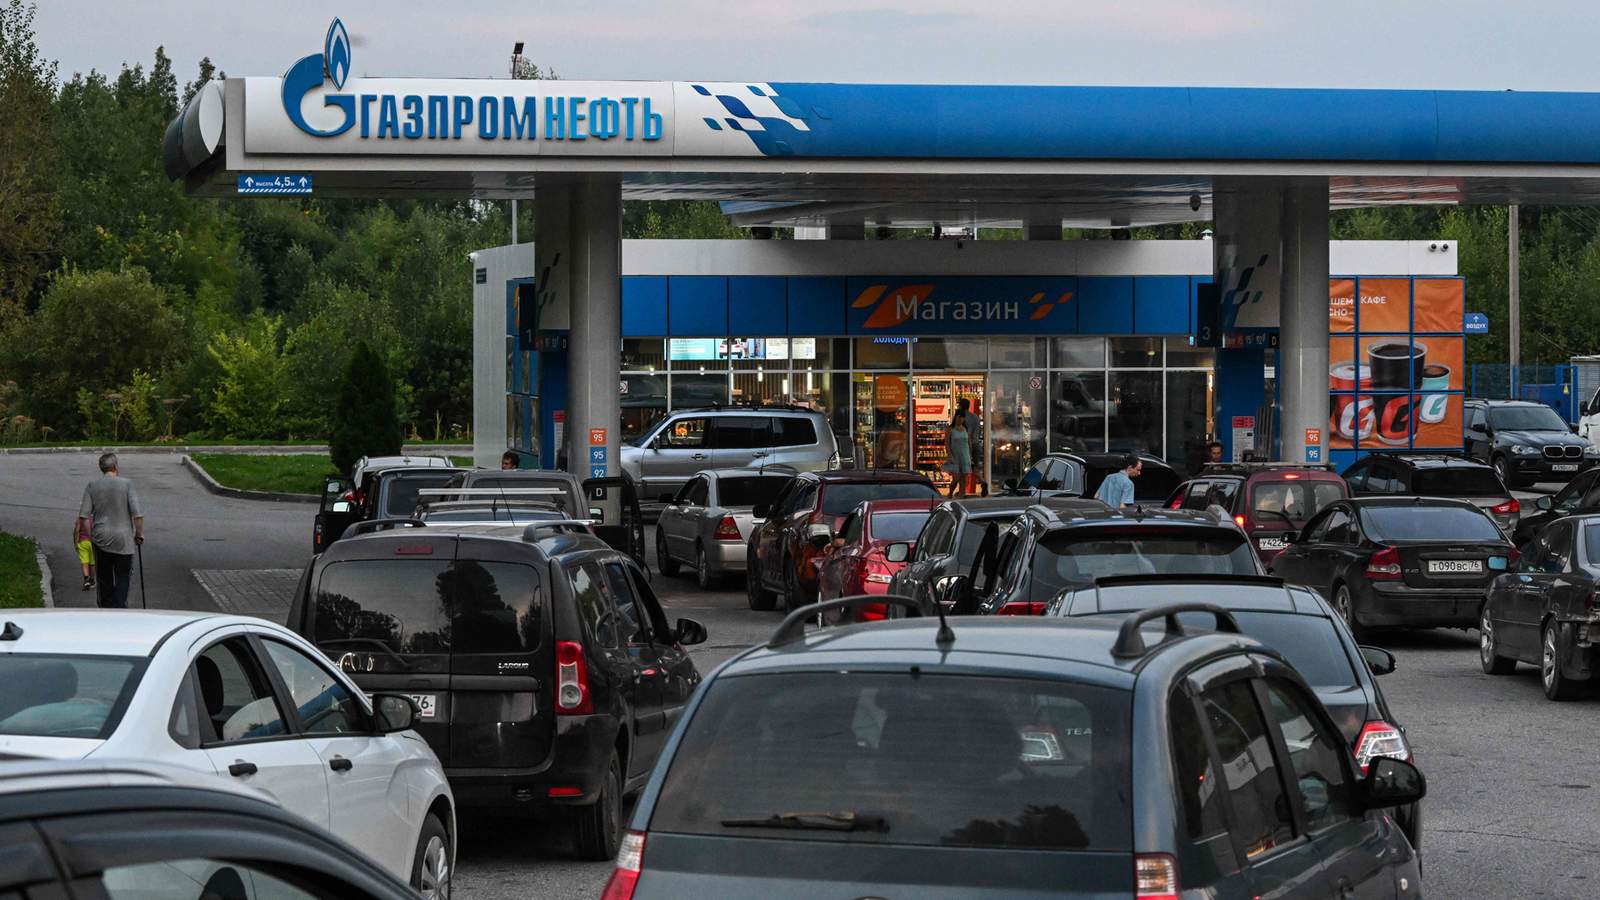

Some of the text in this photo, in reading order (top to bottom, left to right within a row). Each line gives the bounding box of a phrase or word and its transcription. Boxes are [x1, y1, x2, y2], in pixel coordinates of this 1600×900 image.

[1329, 296, 1387, 306] ШЕМ КАФЕ
[895, 295, 1019, 320] Магазин
[1202, 326, 1211, 340] 3
[593, 434, 603, 442] 95
[1308, 434, 1318, 442] 95
[593, 451, 604, 459] 95
[1308, 450, 1318, 458] 95
[594, 469, 604, 478] 92
[596, 488, 603, 496] D
